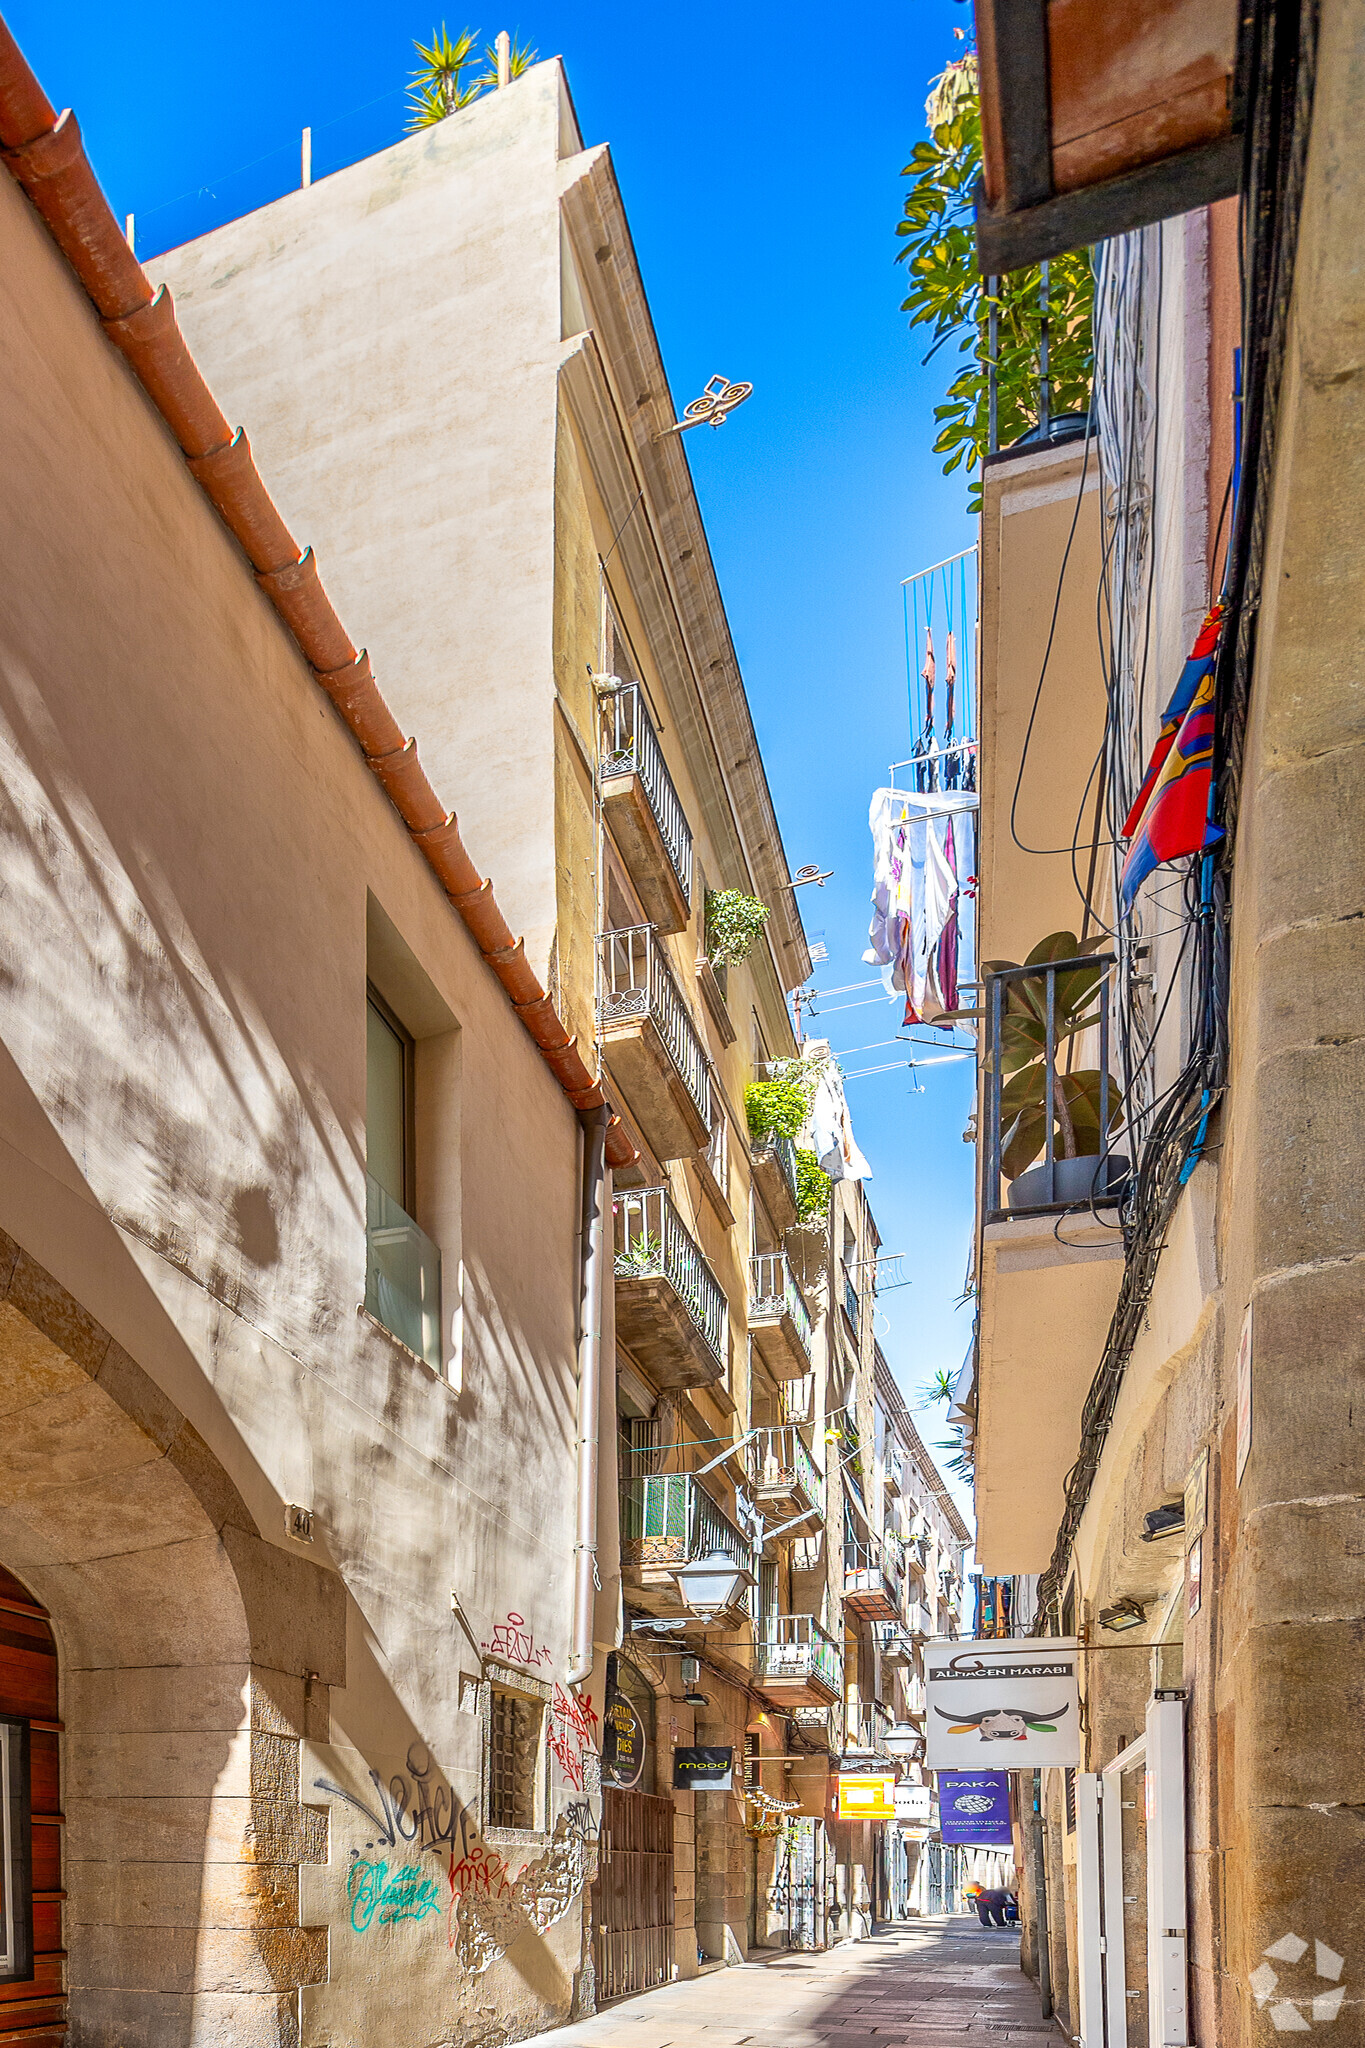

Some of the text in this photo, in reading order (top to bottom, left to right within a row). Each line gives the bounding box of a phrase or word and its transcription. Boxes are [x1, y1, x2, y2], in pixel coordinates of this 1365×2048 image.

[294, 1513, 310, 1535] 40
[1010, 1666, 1067, 1675] MARABI
[617, 1737, 633, 1754] DIES
[679, 1760, 728, 1769] mood
